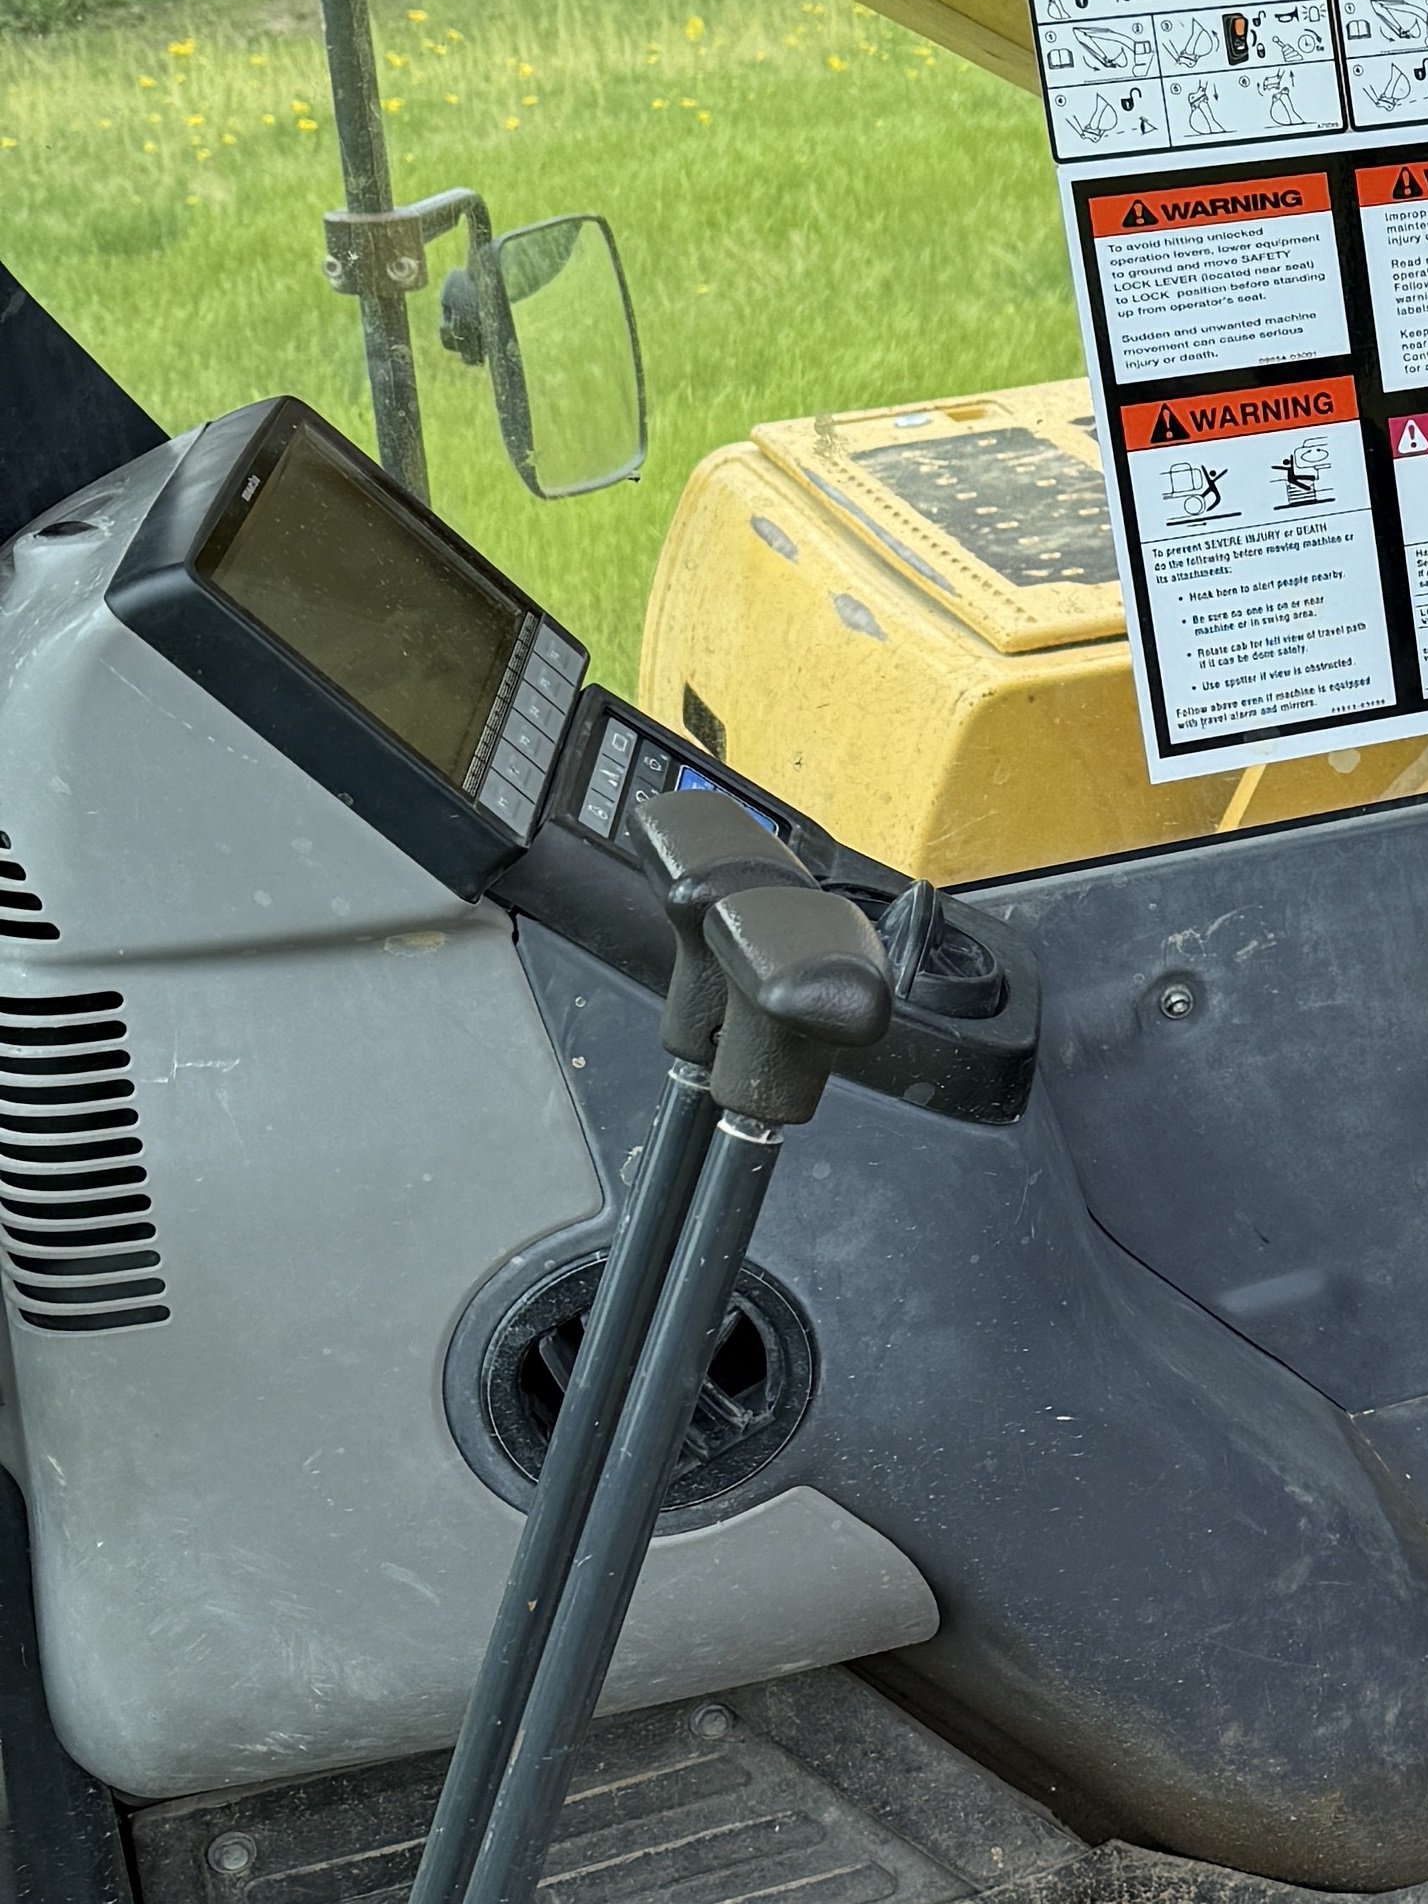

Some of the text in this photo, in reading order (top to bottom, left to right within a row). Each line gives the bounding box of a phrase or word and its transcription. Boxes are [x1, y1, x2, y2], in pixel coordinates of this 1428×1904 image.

[1161, 190, 1302, 221] WARNING
[1108, 228, 1263, 253] To avoid hitting unlocked
[1114, 260, 1315, 292] LOCK LEVER (located near seat)
[1189, 392, 1334, 432] WARNING
